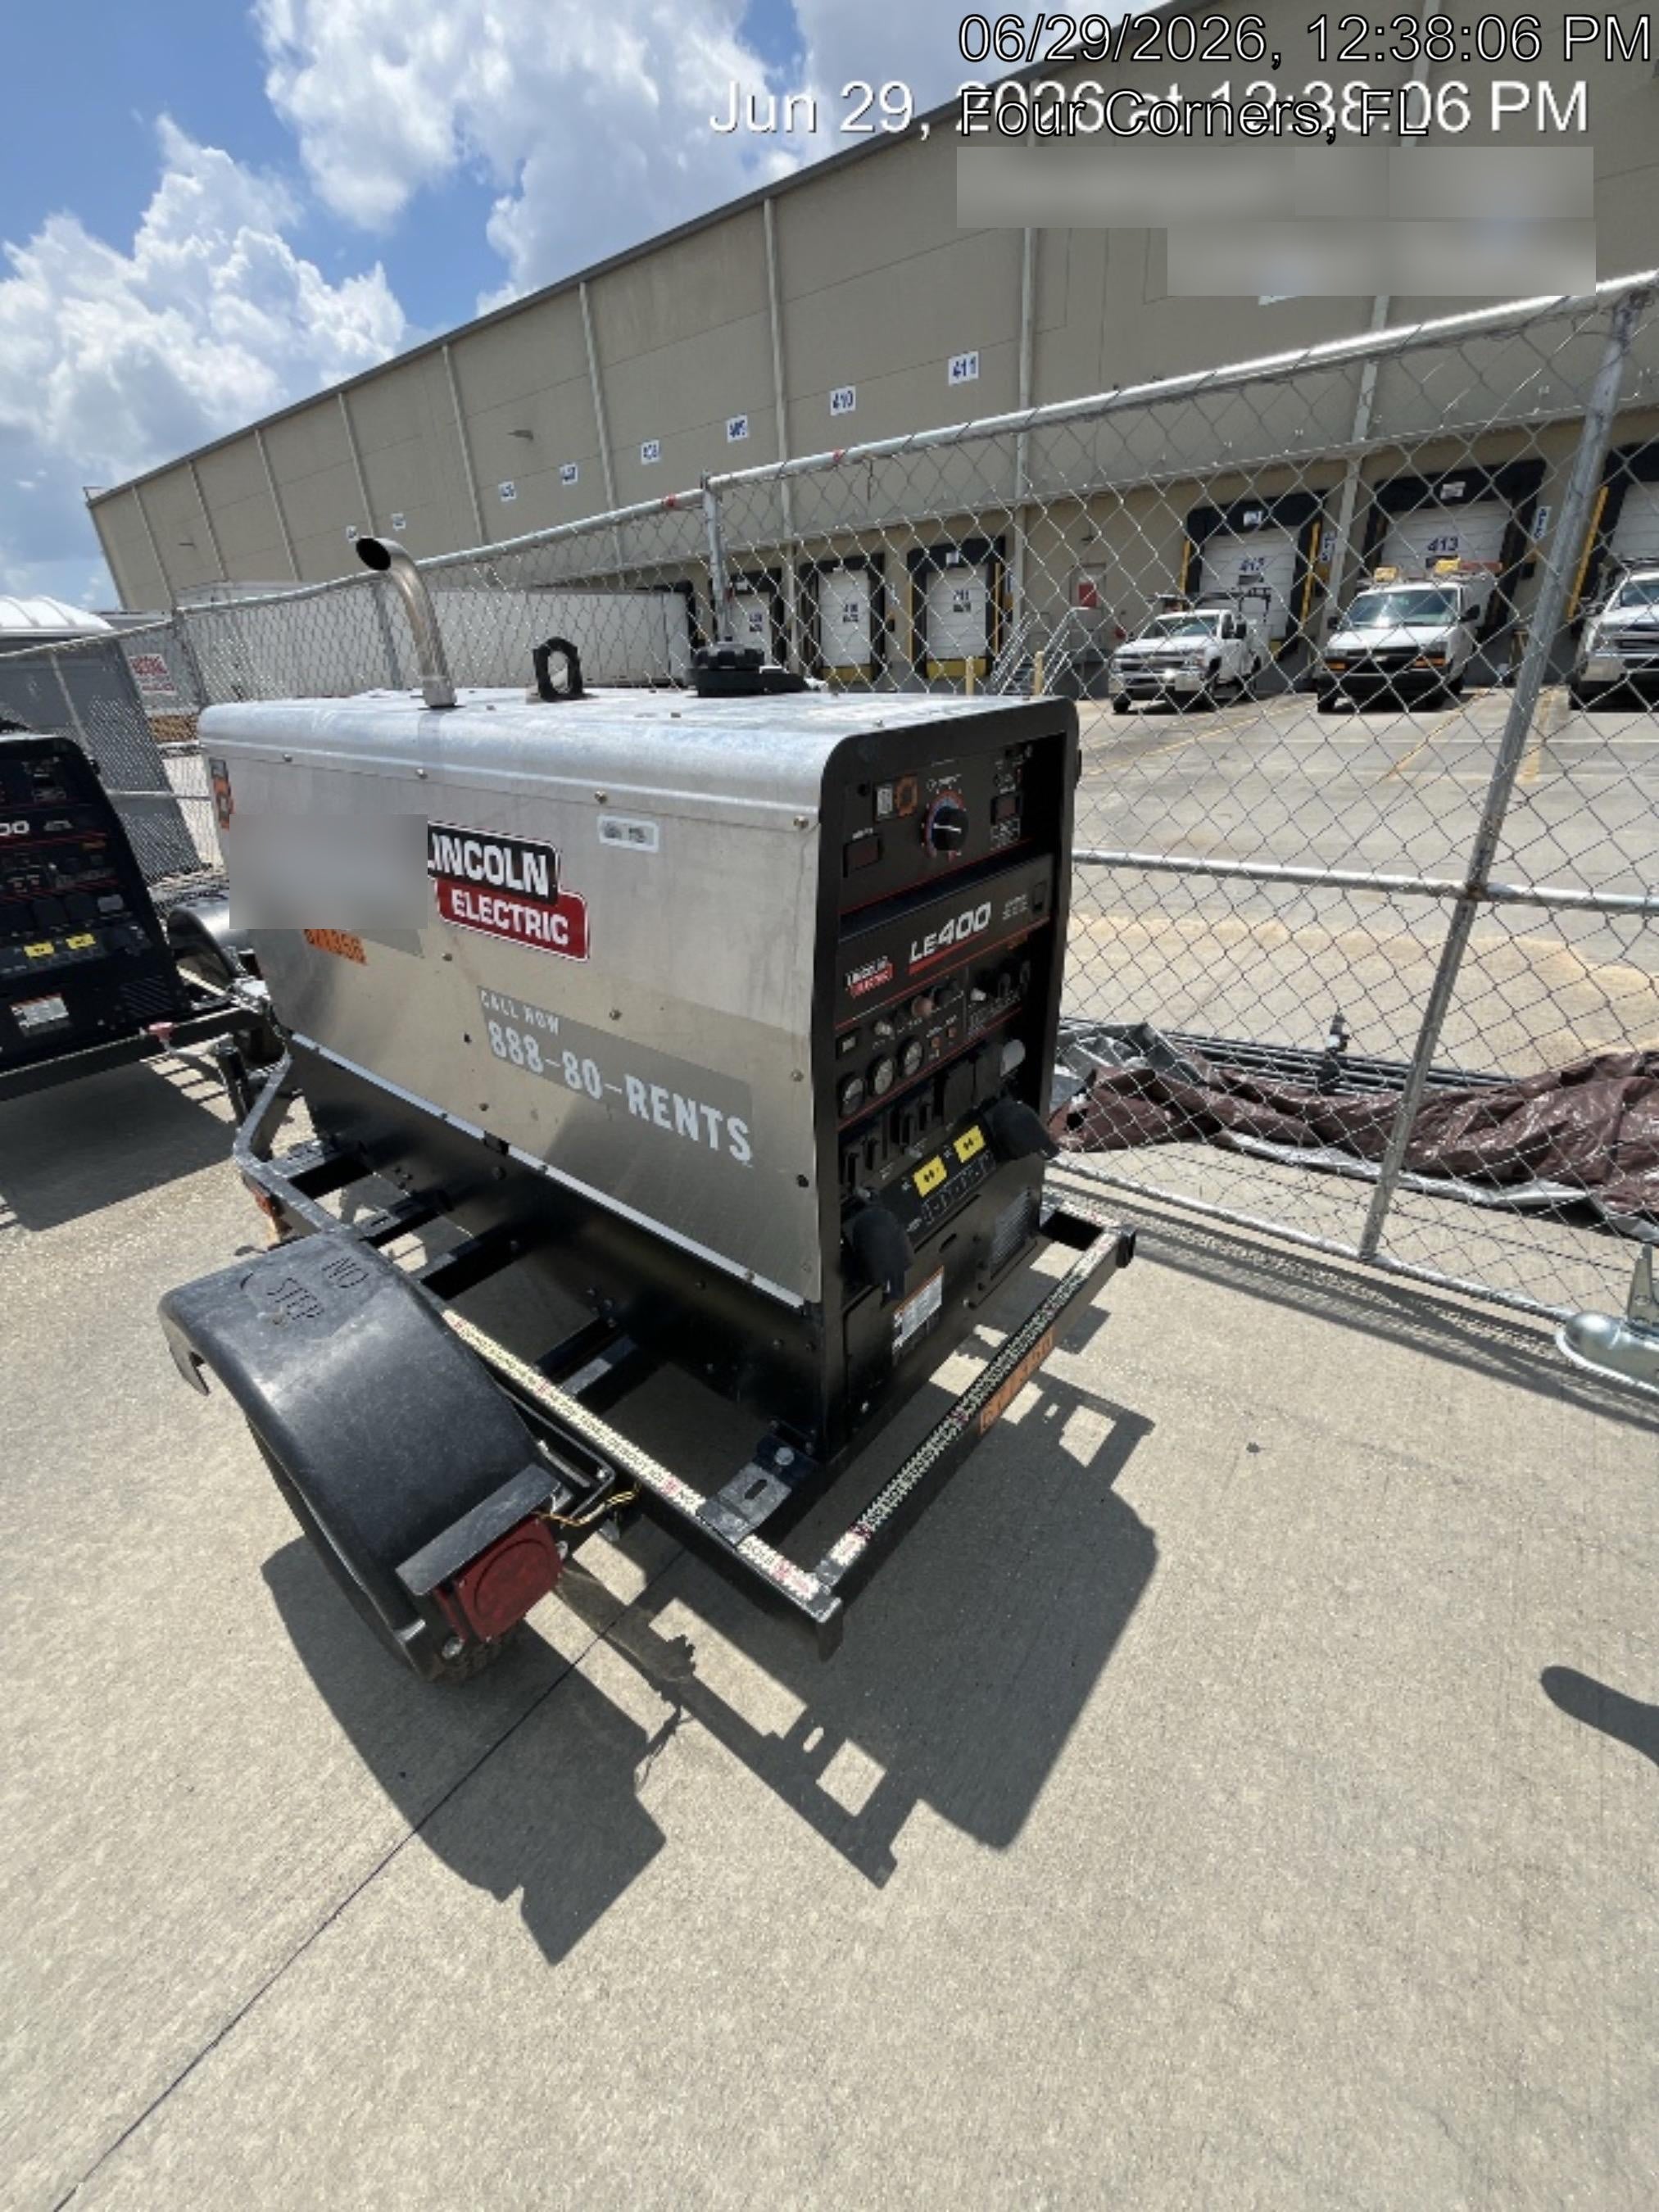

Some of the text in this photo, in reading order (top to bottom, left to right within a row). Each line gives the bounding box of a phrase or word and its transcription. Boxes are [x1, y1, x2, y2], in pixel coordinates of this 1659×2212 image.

[428, 832, 550, 899] INCOLN
[451, 888, 570, 945] ELECTRIC
[909, 901, 992, 964] LE400
[480, 989, 560, 1036] CALL NOW
[488, 1019, 753, 1162] 888-80-RENTS
[266, 1276, 325, 1321] STEP
[321, 1256, 369, 1290] NO
